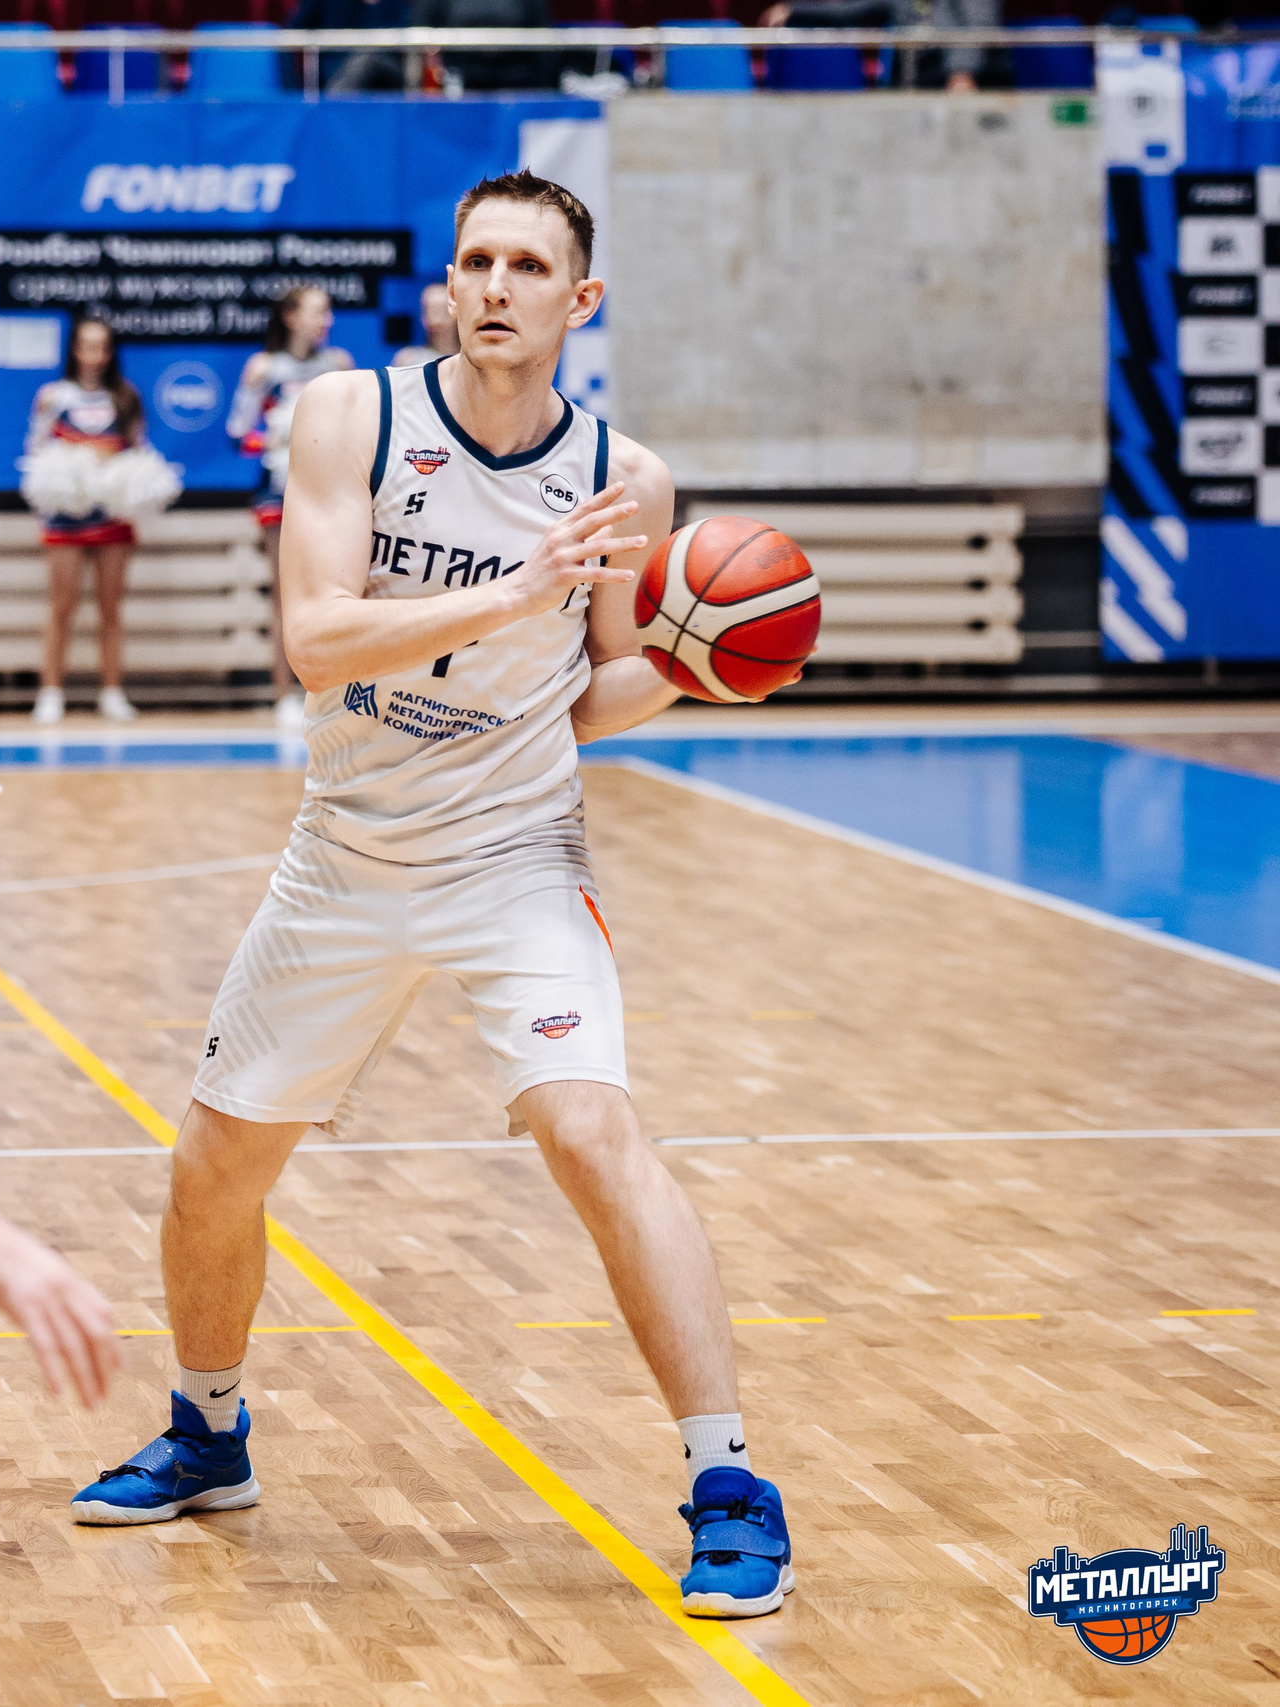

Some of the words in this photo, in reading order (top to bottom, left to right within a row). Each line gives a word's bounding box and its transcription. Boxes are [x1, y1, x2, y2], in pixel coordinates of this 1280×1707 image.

[82, 164, 295, 213] FONBET
[405, 451, 450, 462] МЕТАЛЛУРГ
[544, 485, 574, 503] РФБ
[370, 530, 526, 588] МЕТАЛ
[391, 690, 524, 727] МАГНИТОГОРСК
[532, 1017, 581, 1031] МЕТАЛЛУРГ
